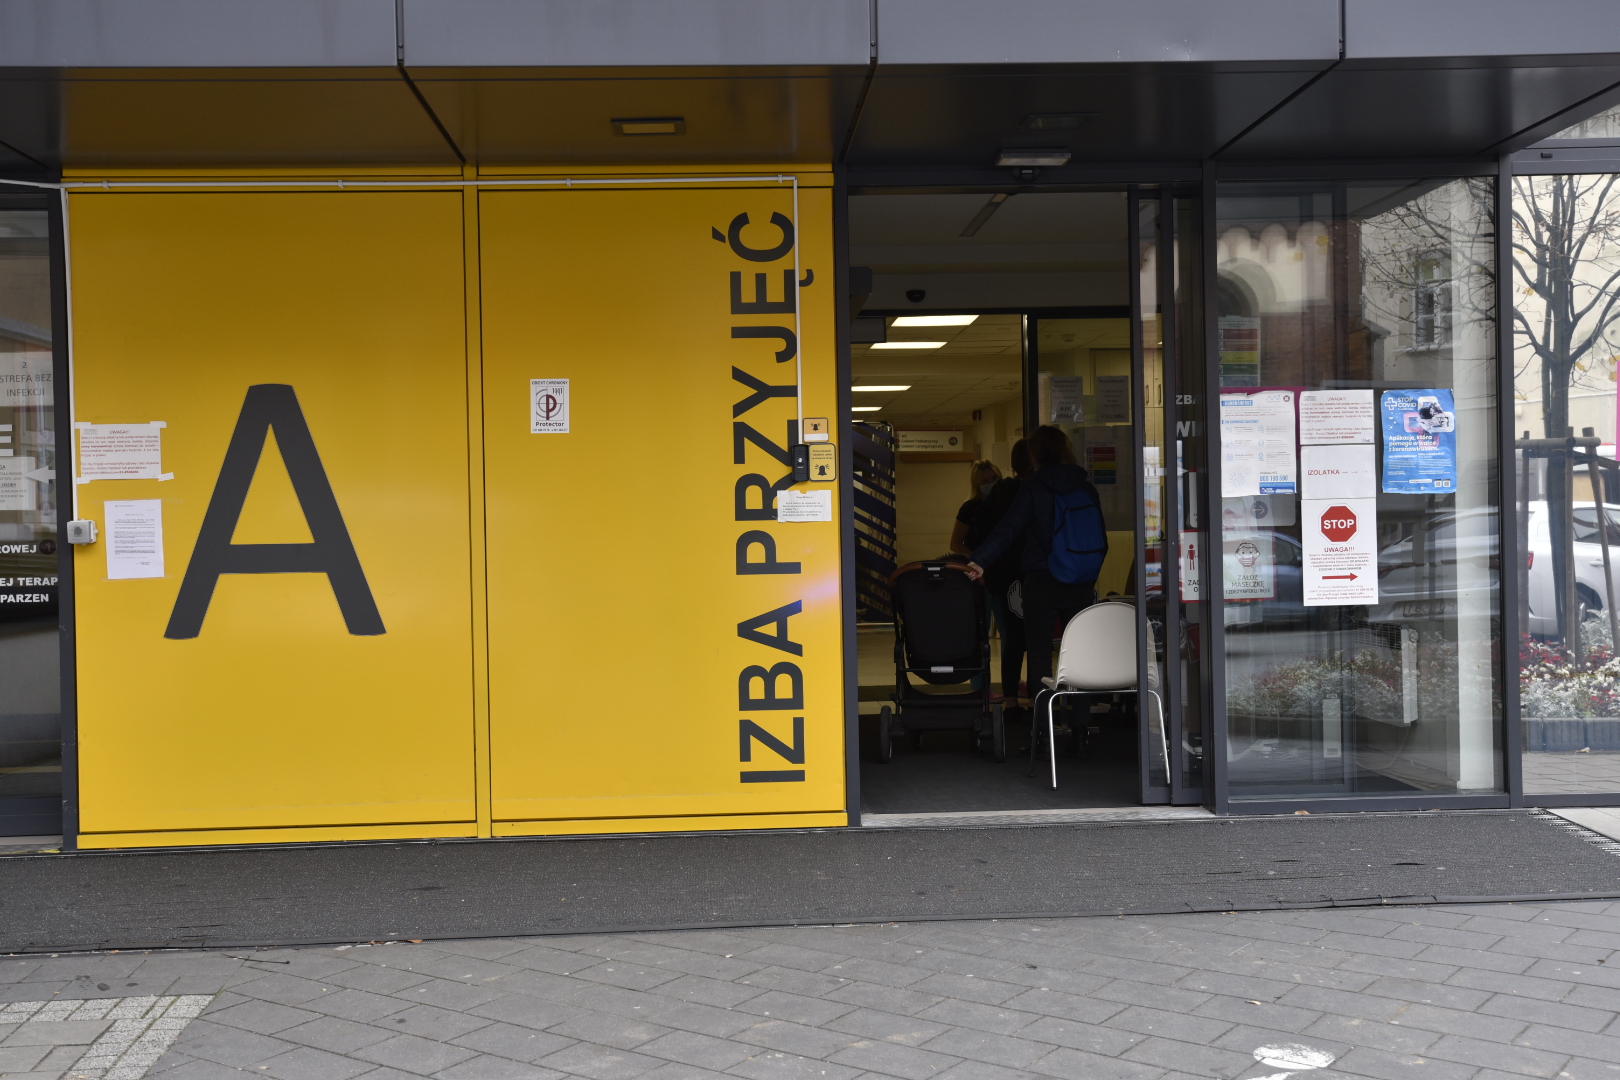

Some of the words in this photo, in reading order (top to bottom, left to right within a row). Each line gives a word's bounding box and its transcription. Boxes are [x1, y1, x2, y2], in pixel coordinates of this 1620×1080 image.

[22, 361, 28, 369] 2
[0, 374, 32, 383] STREFA
[35, 374, 52, 382] BEZ
[6, 388, 45, 397] INFEKCJI
[712, 211, 814, 575] PRZYJĘĆ
[164, 384, 387, 639] A
[1323, 519, 1355, 530] STOP
[0, 544, 37, 554] OWEJ
[17, 577, 58, 586] TERAP
[1231, 581, 1264, 589] MASECZKĘ
[737, 600, 805, 783] IZBA
